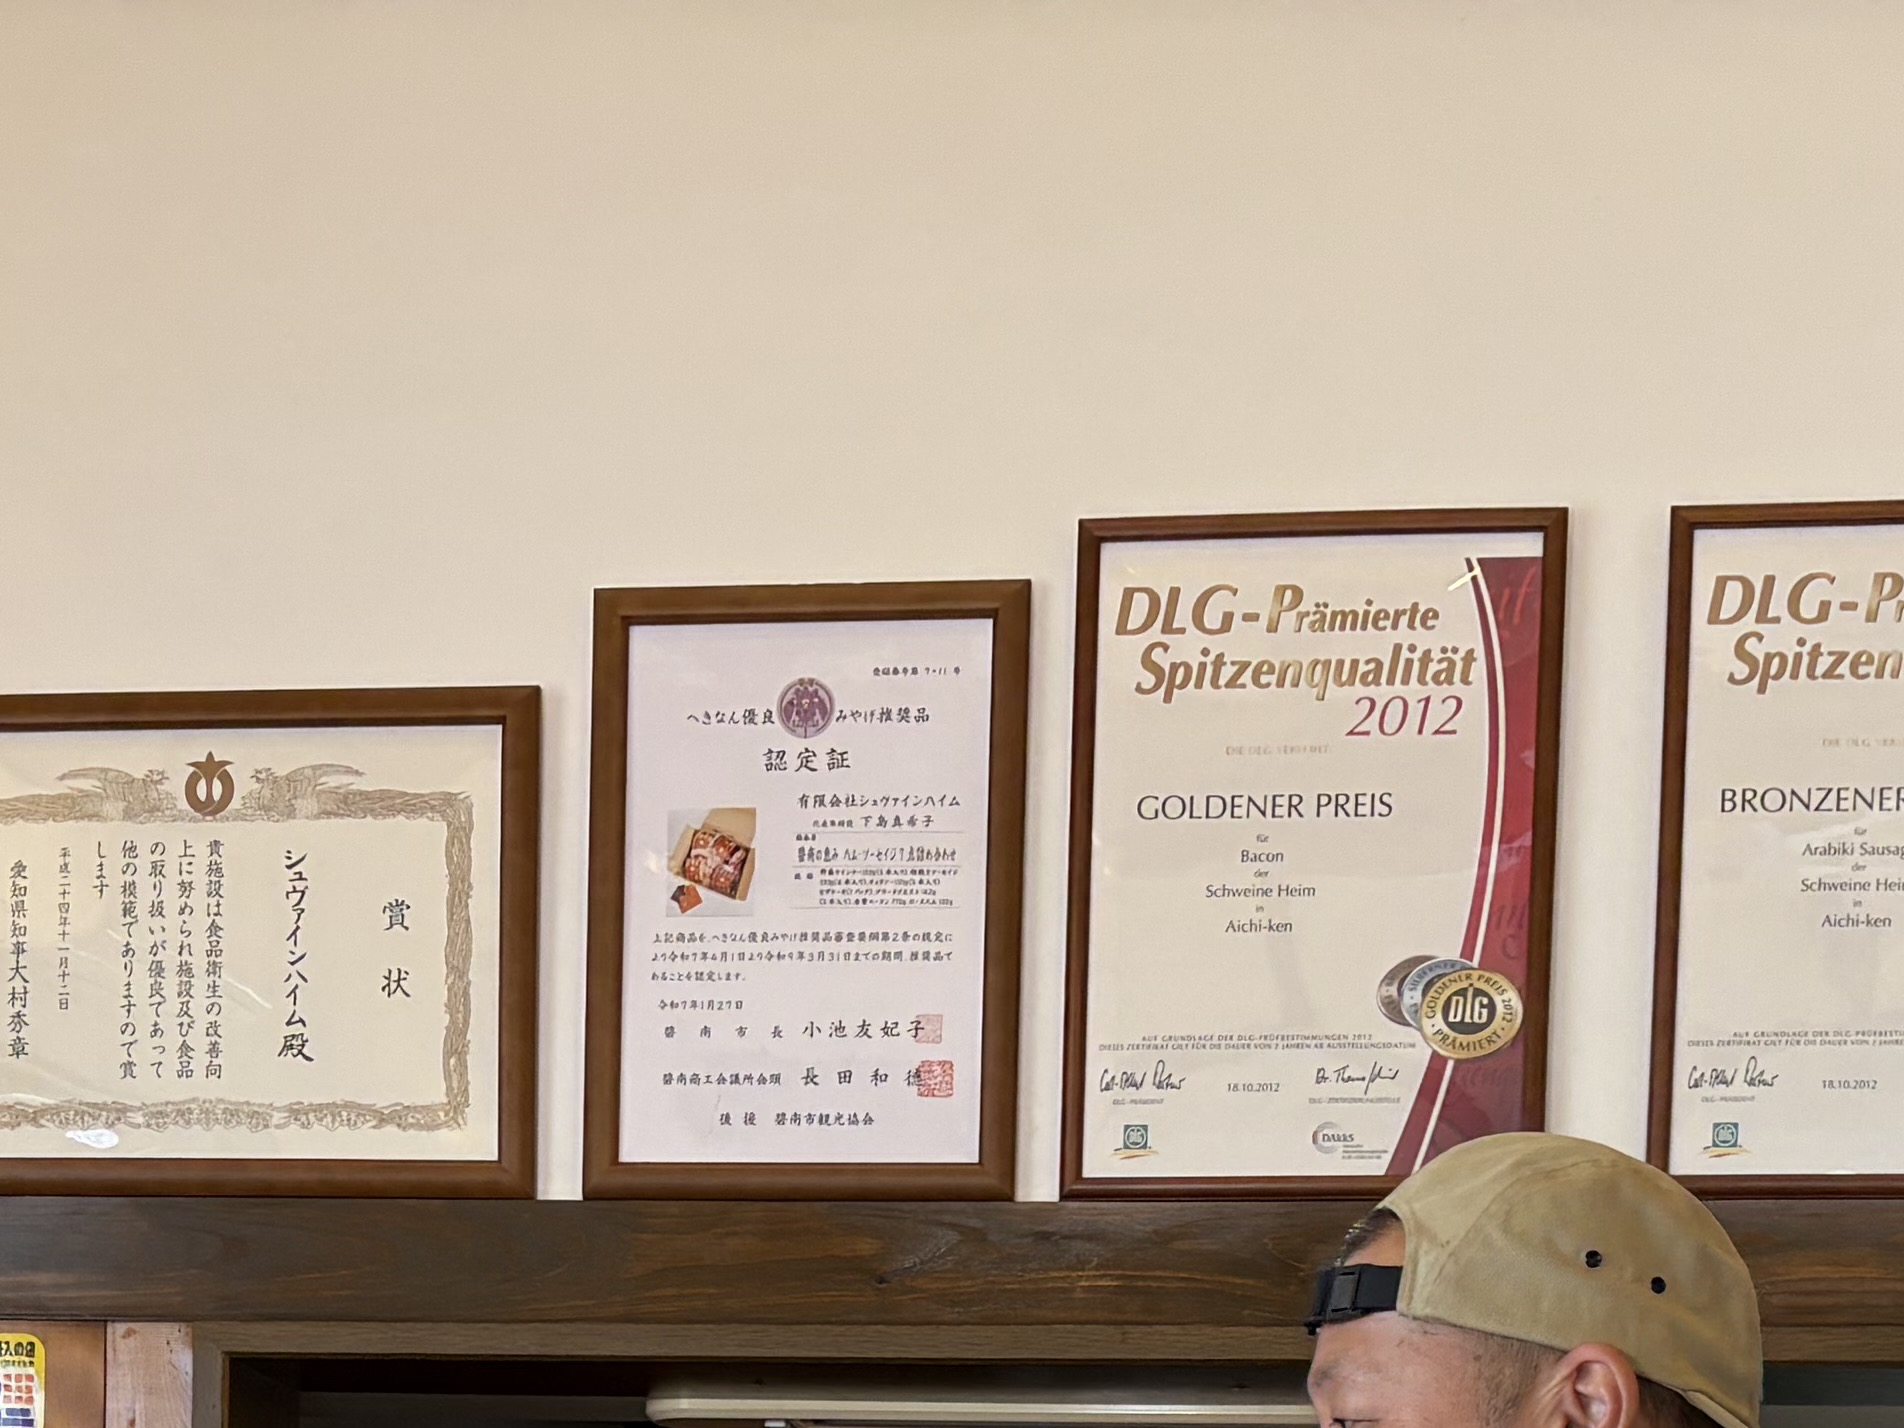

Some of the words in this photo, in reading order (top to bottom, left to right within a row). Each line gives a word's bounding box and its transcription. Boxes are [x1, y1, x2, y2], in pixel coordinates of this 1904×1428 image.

[1114, 583, 1441, 638] DLG-Prämierte
[1133, 641, 1478, 704] Spitzenqualität
[1345, 694, 1464, 737] 2012
[762, 746, 852, 773] 認定証
[1136, 793, 1305, 822] GOLDENER
[1315, 792, 1394, 820] PREIS
[1240, 848, 1285, 863] Bacon
[1801, 841, 1855, 858] Arabiki
[93, 840, 111, 900] します
[1204, 883, 1274, 899] Schweine
[1277, 883, 1317, 899] Heim
[1800, 876, 1872, 893] Schweine
[1224, 918, 1294, 934] Aichi-ken
[1821, 912, 1893, 930] Aichi-ken
[5, 858, 32, 1061] 愛知県知事大村秀章
[203, 839, 226, 1081] 貴施設は食品衛生の改善向
[276, 848, 315, 1064] シュヴァインハイム殿
[1226, 1082, 1281, 1094] 18.10.2012
[1821, 1079, 1878, 1091] 18.10.2012
